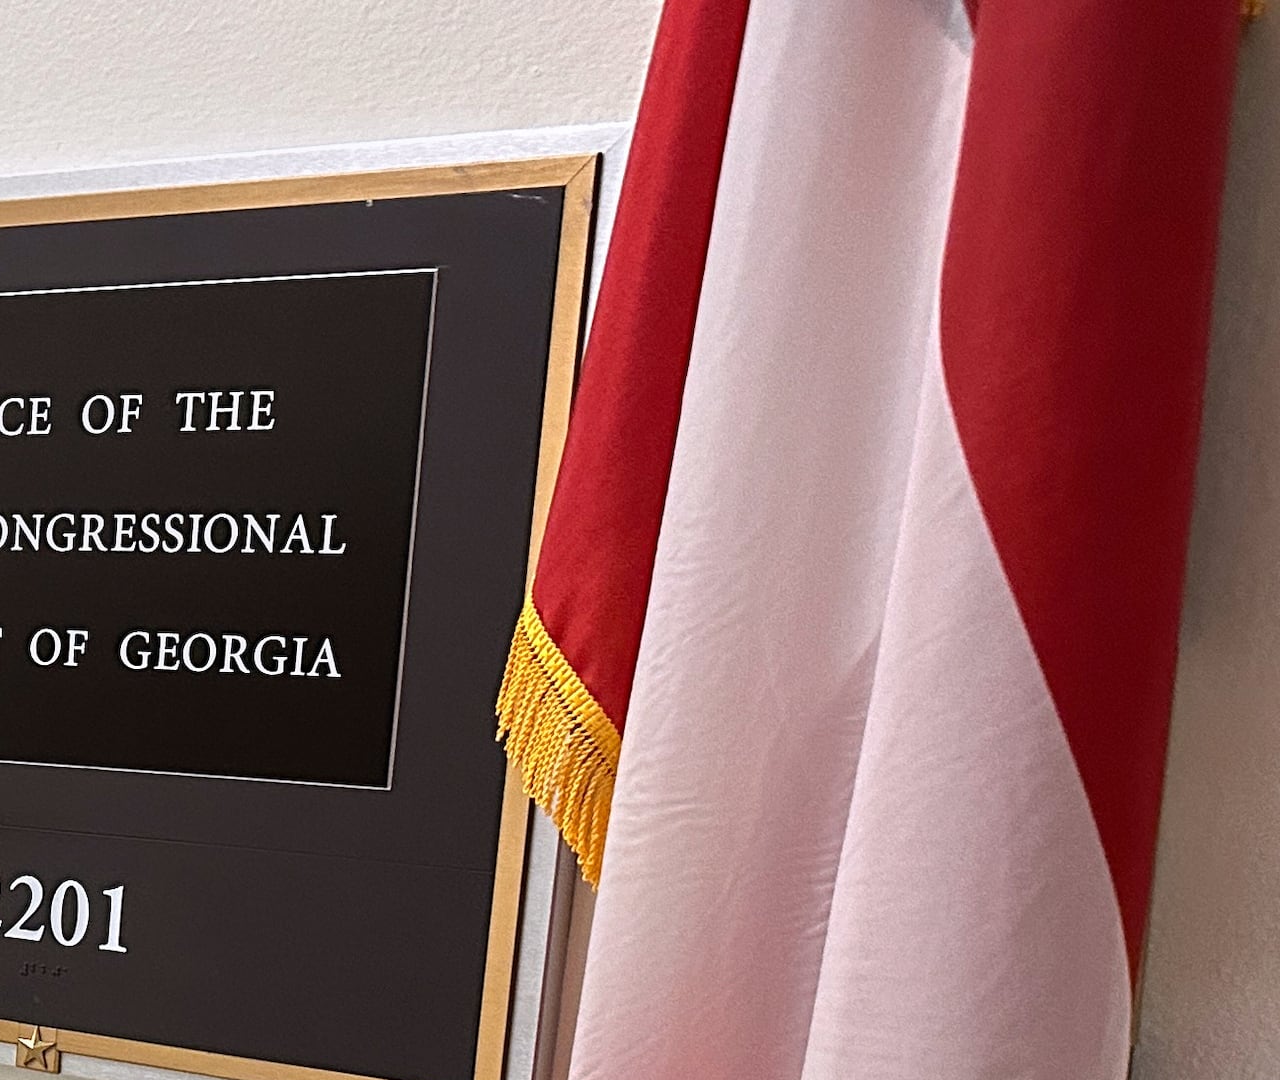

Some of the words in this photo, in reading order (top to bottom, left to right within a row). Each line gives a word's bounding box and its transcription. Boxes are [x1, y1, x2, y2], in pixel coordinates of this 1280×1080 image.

[80, 393, 144, 436] OF
[174, 389, 276, 433] THE
[28, 627, 90, 668] OF
[118, 629, 343, 679] GEORGIA
